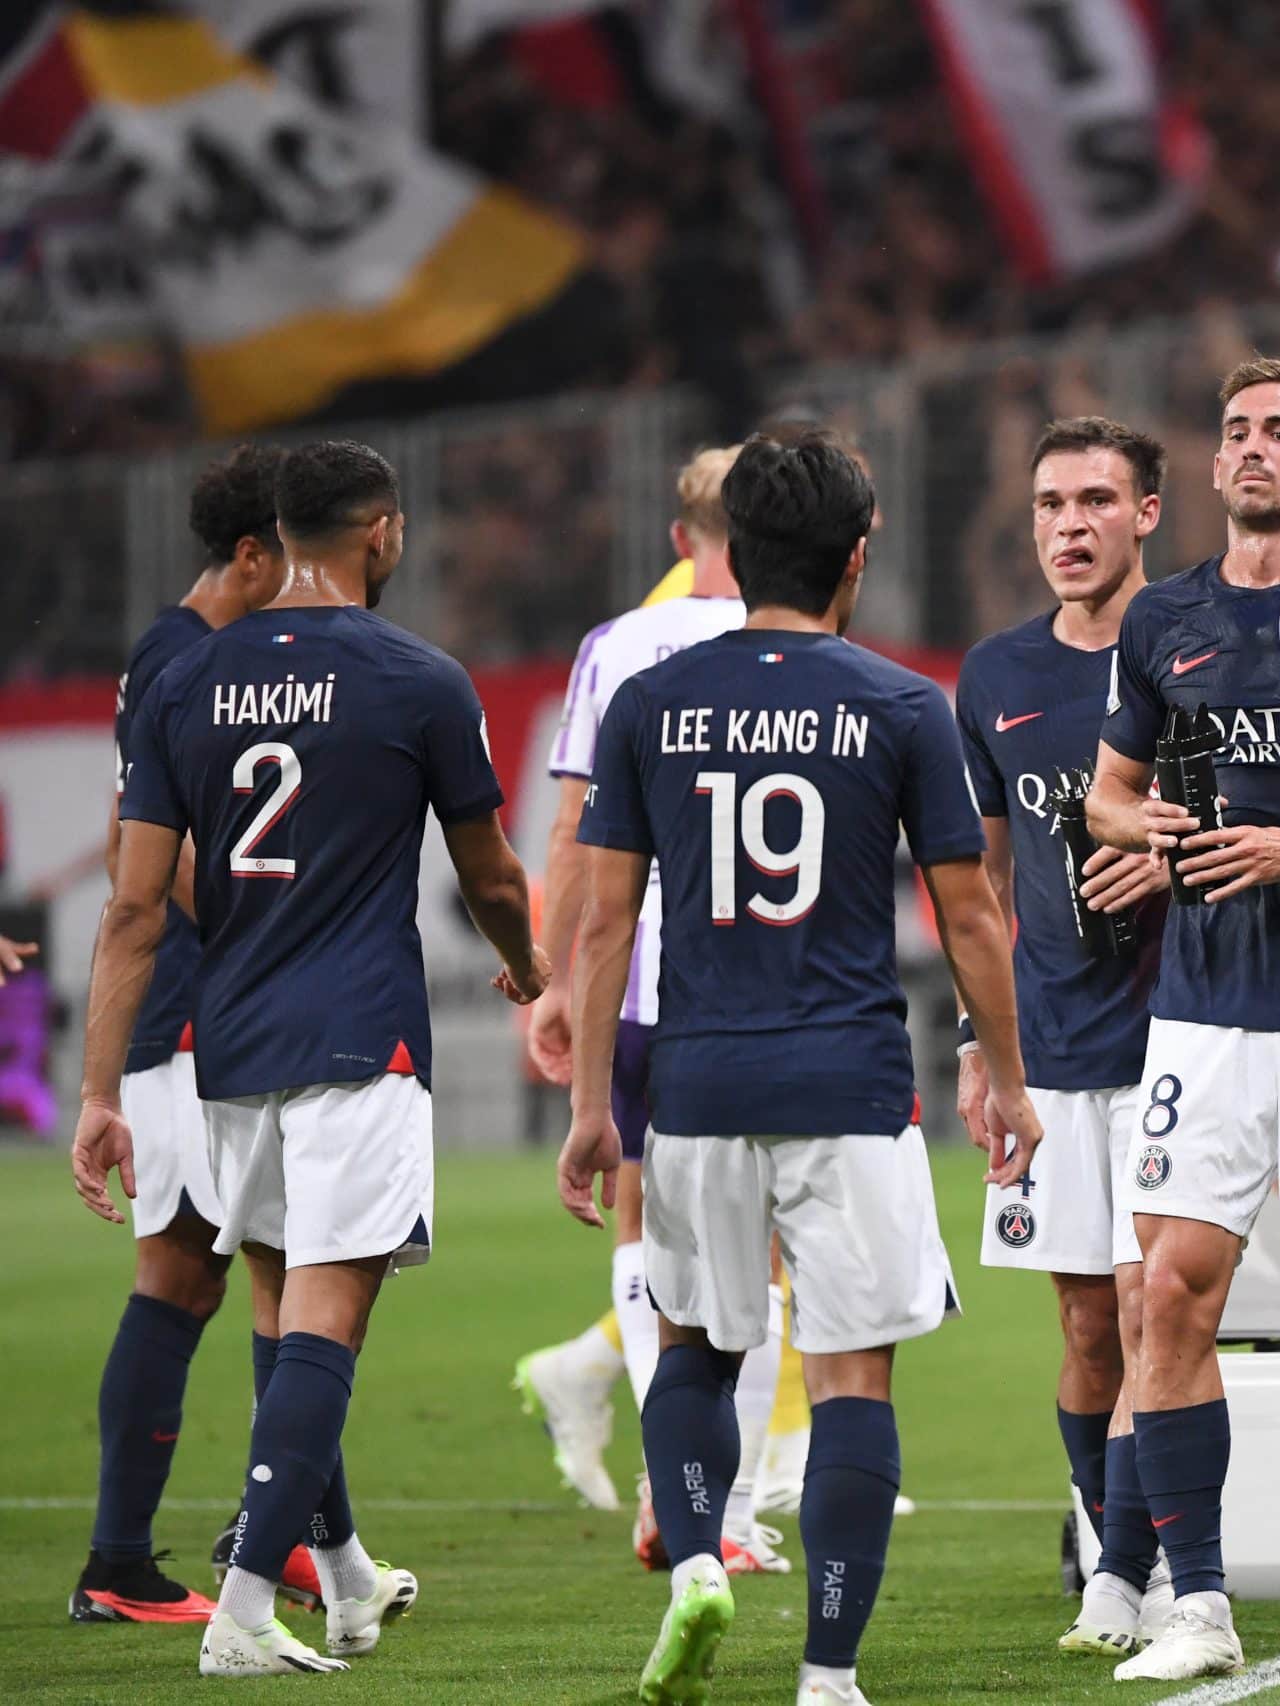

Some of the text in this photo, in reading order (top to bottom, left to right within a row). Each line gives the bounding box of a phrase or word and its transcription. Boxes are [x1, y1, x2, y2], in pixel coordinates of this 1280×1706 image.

[660, 708, 713, 754] LEE
[726, 709, 820, 754] KANG
[230, 741, 302, 880] 2
[694, 771, 826, 927] 19
[1142, 1073, 1182, 1140] 8
[683, 1461, 712, 1515] PARIS
[821, 1560, 846, 1620] PARIS
